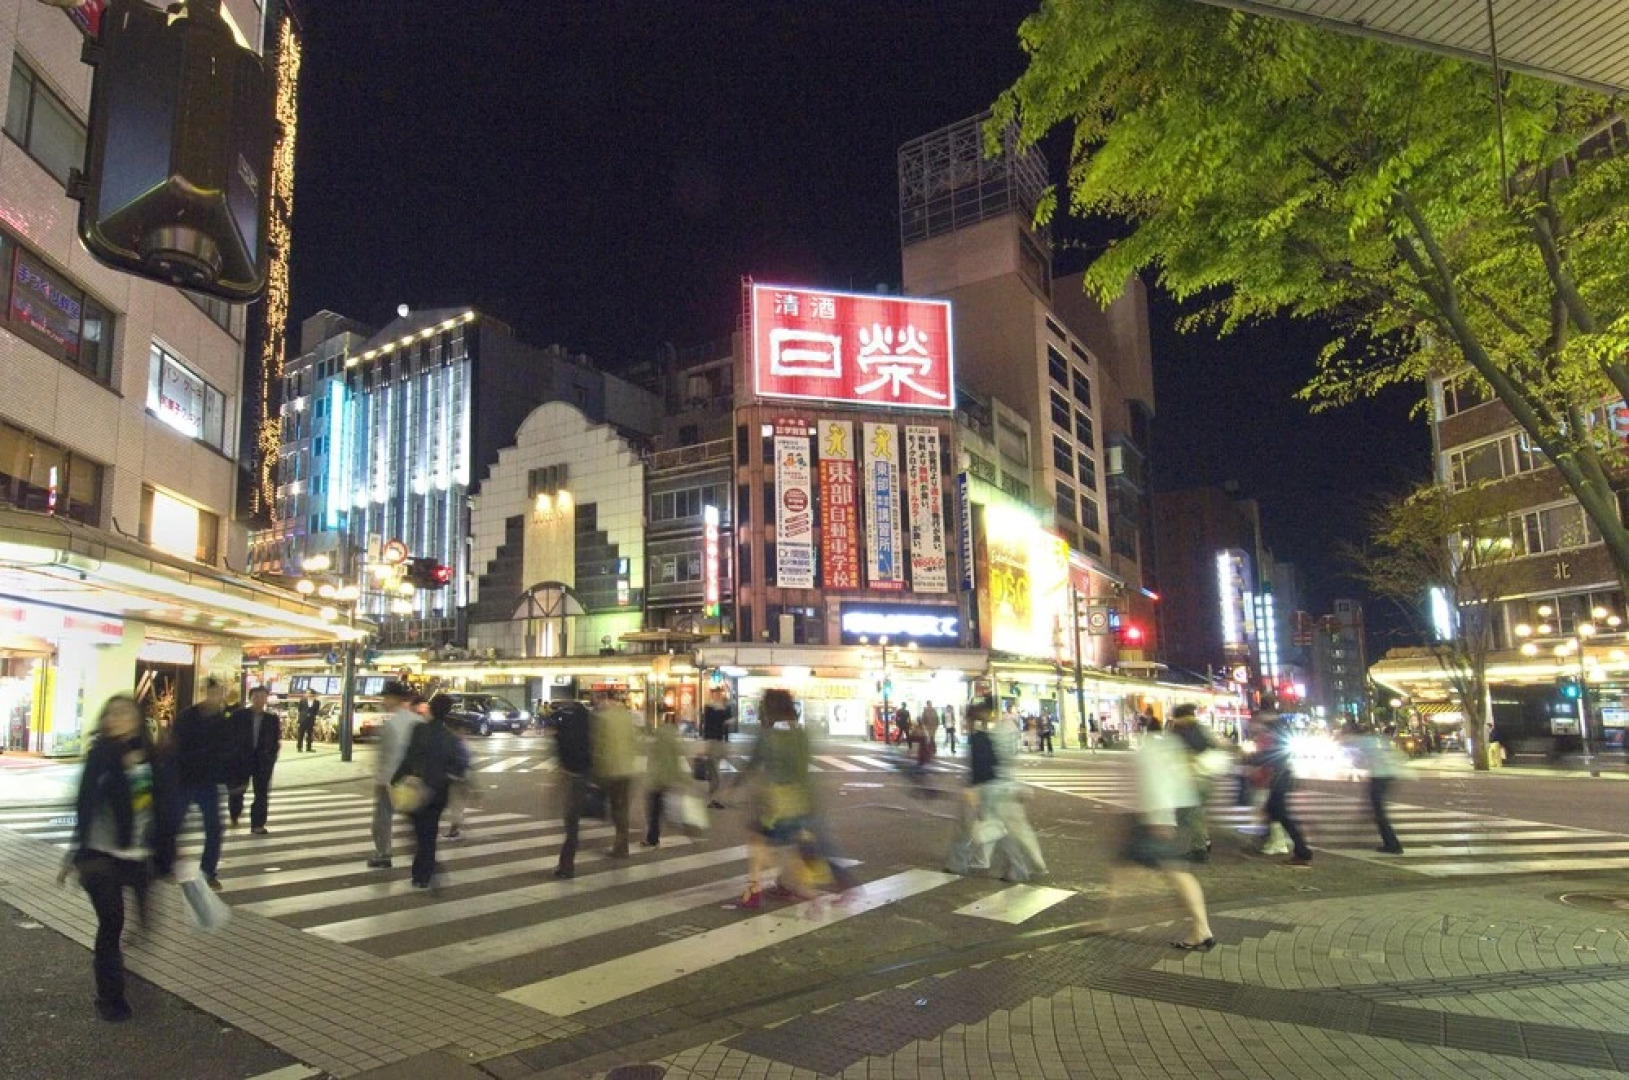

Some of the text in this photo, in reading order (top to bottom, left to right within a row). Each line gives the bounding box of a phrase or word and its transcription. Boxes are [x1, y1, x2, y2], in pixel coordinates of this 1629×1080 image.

[774, 292, 836, 320] 清酒
[828, 460, 853, 587] 東部自動車学校
[1553, 561, 1571, 580] 北
